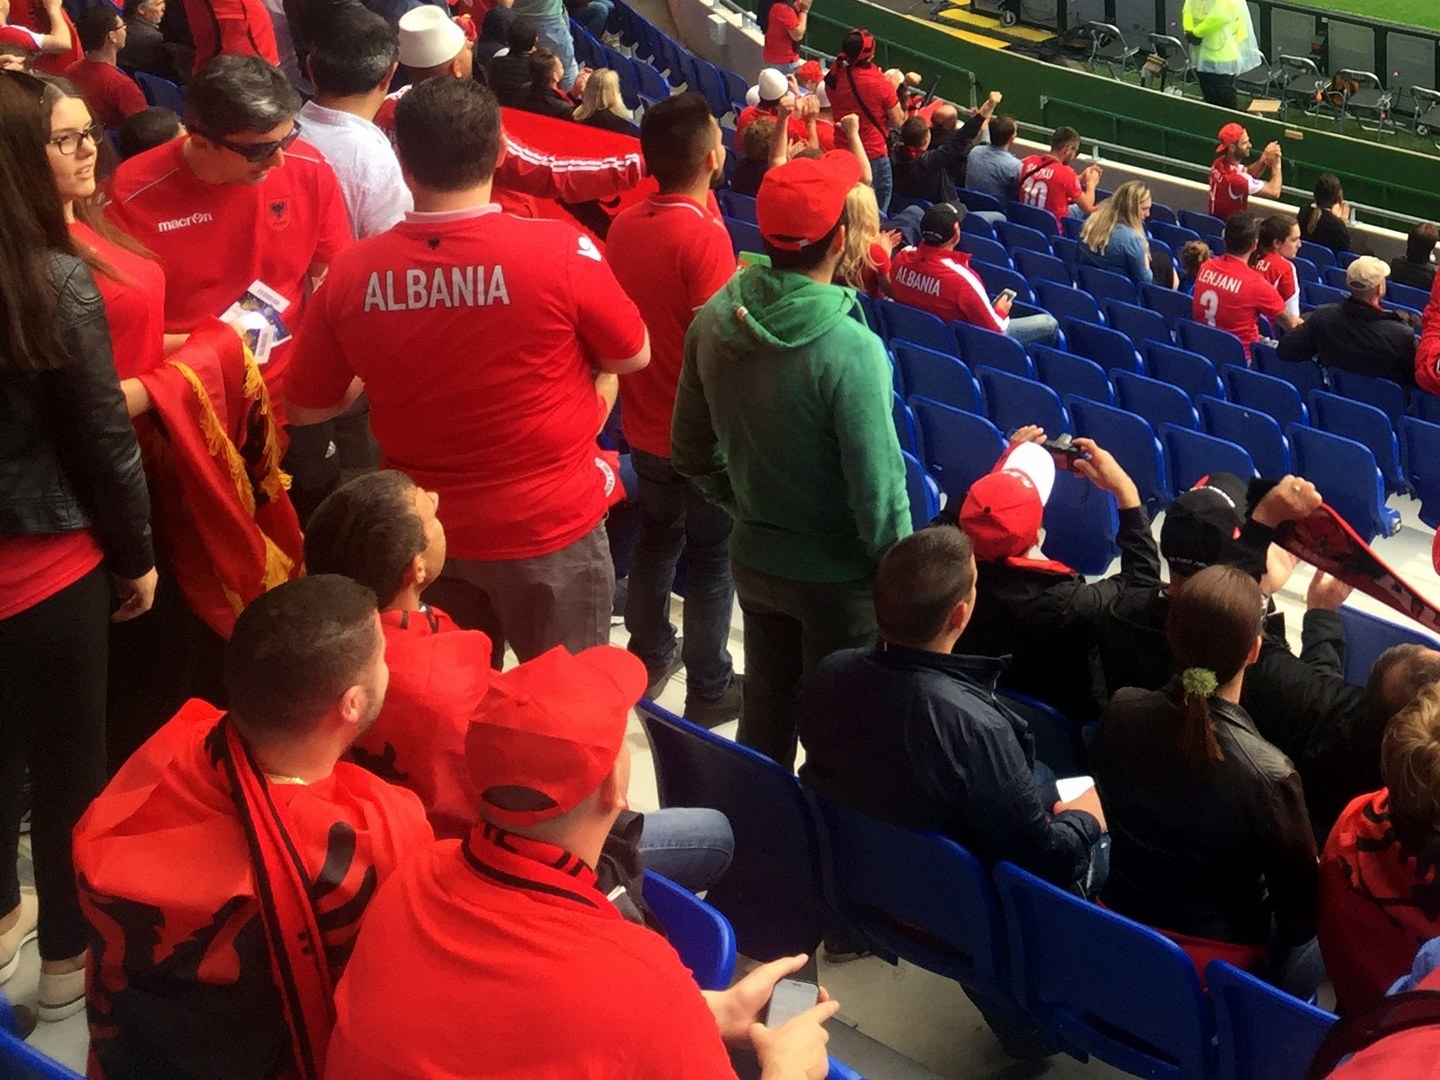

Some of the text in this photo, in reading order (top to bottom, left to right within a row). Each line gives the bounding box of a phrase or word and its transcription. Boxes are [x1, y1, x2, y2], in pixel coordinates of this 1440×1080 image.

[1022, 176, 1048, 209] 10
[158, 211, 213, 233] macron
[364, 264, 511, 312] ALBANIA
[895, 265, 940, 297] ALBANIA
[1198, 268, 1243, 294] LENJANI
